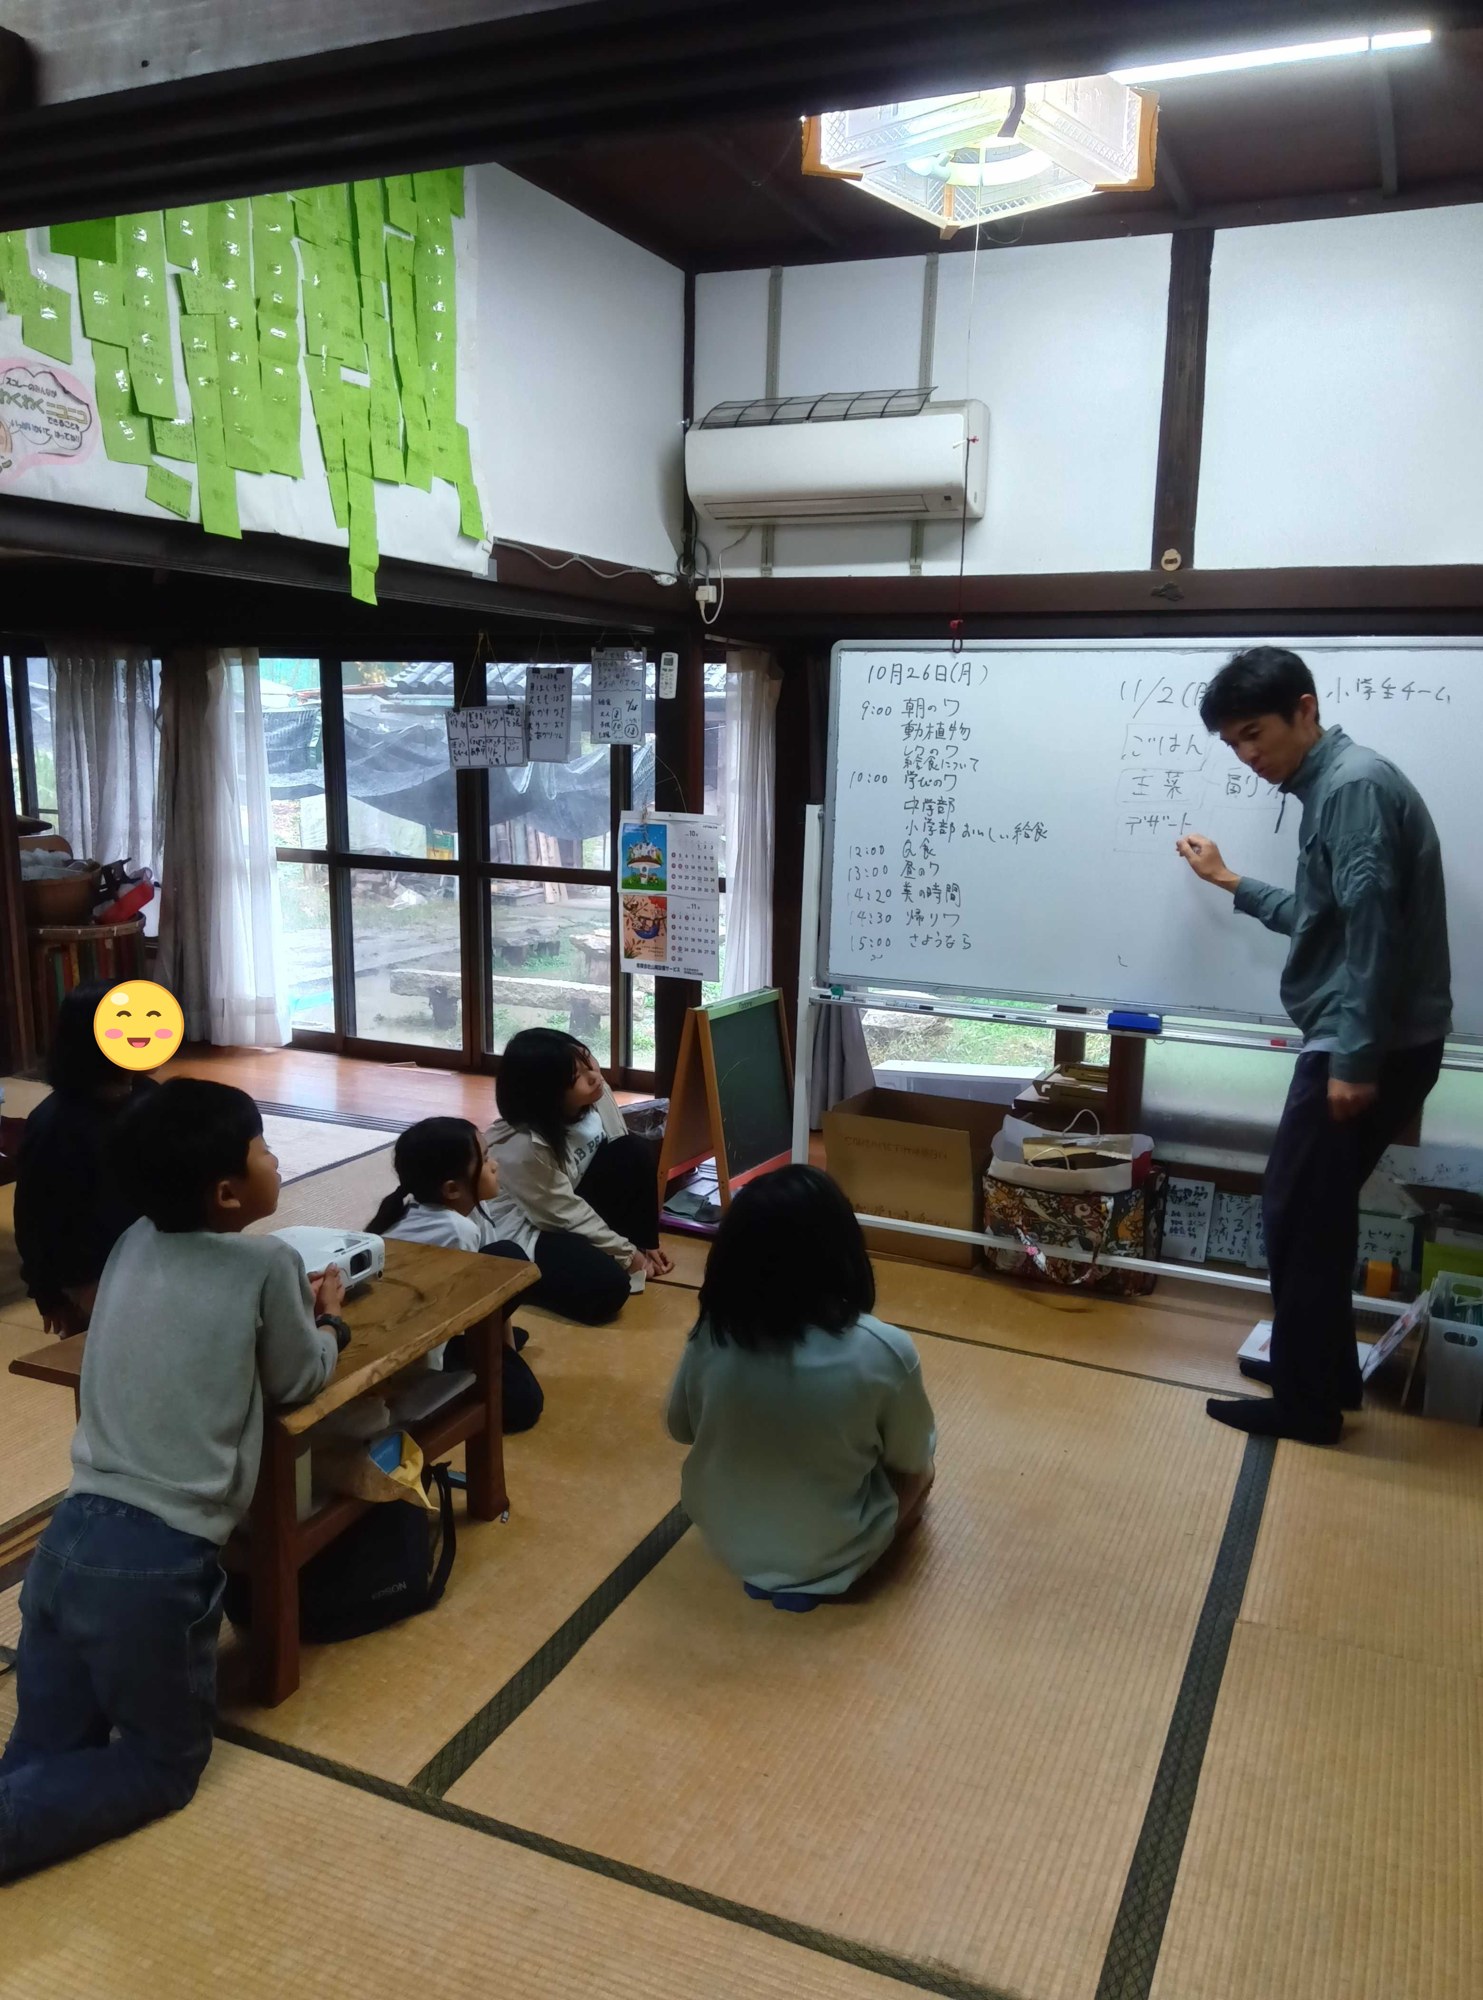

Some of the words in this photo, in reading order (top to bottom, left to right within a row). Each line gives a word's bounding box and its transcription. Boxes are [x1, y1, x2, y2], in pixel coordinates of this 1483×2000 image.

[47, 416, 80, 432] できることを
[868, 662, 988, 686] 10月26日(月)
[861, 700, 892, 721] 9:00
[901, 697, 960, 719] 朝のワ
[902, 720, 971, 741] 動植物
[849, 771, 888, 789] 10:00
[849, 845, 885, 858] 12:00
[848, 865, 889, 882] 13:00
[847, 889, 893, 906] 14:20
[849, 911, 893, 928] 14:30
[850, 935, 892, 952] 15:00
[909, 933, 973, 950] さようなら
